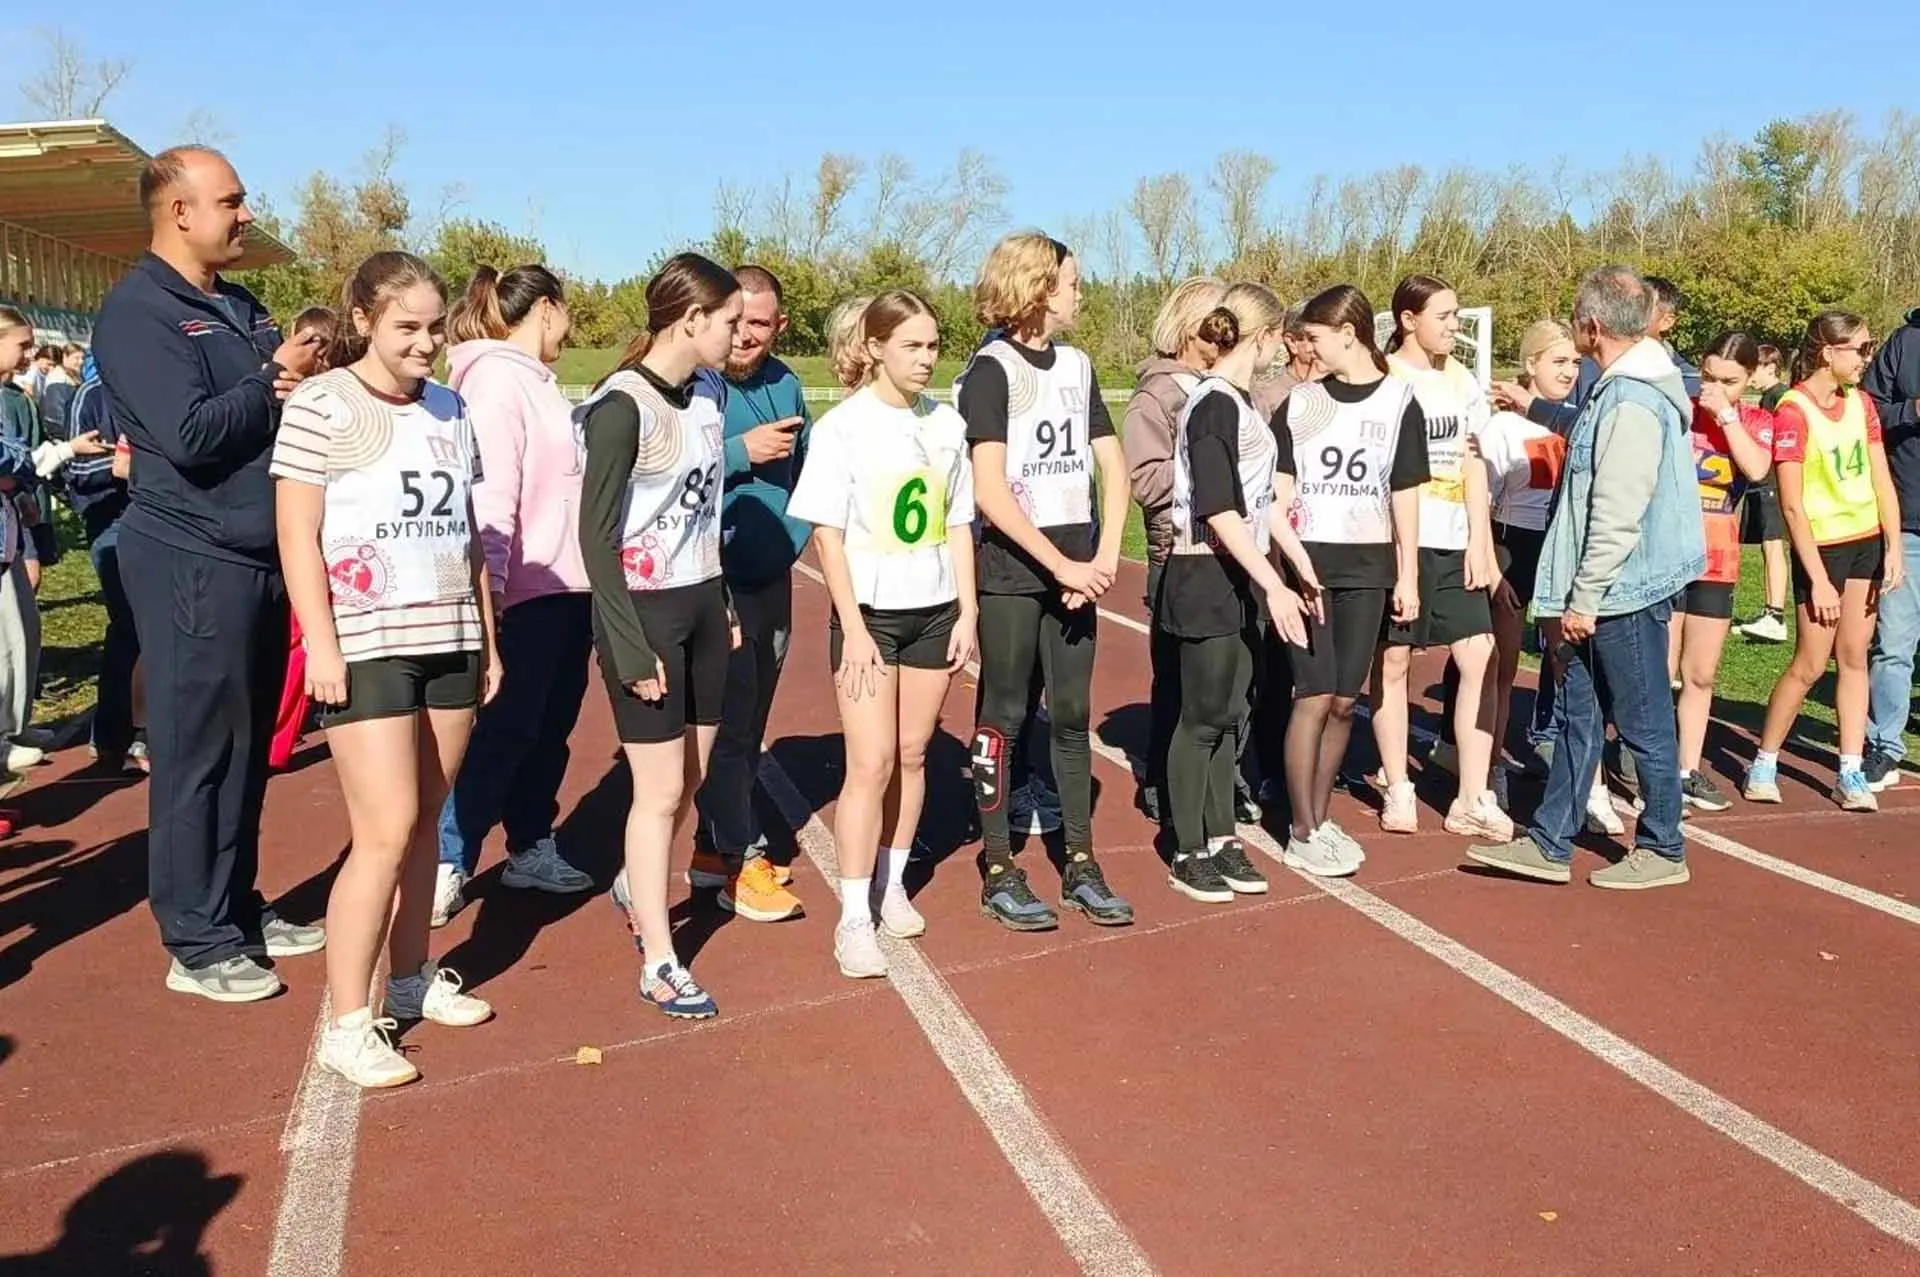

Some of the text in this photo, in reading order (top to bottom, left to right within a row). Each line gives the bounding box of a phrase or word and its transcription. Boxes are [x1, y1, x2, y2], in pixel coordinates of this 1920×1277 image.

[1036, 417, 1077, 459] 91
[1022, 459, 1085, 478] БУГУЛЬМ
[1320, 446, 1368, 482] 96
[1831, 439, 1864, 482] 14
[400, 470, 455, 518] 52
[1302, 482, 1379, 498] БУГУЛЬМА
[376, 520, 466, 539] БУГУЛЬМА
[893, 477, 928, 544] 6
